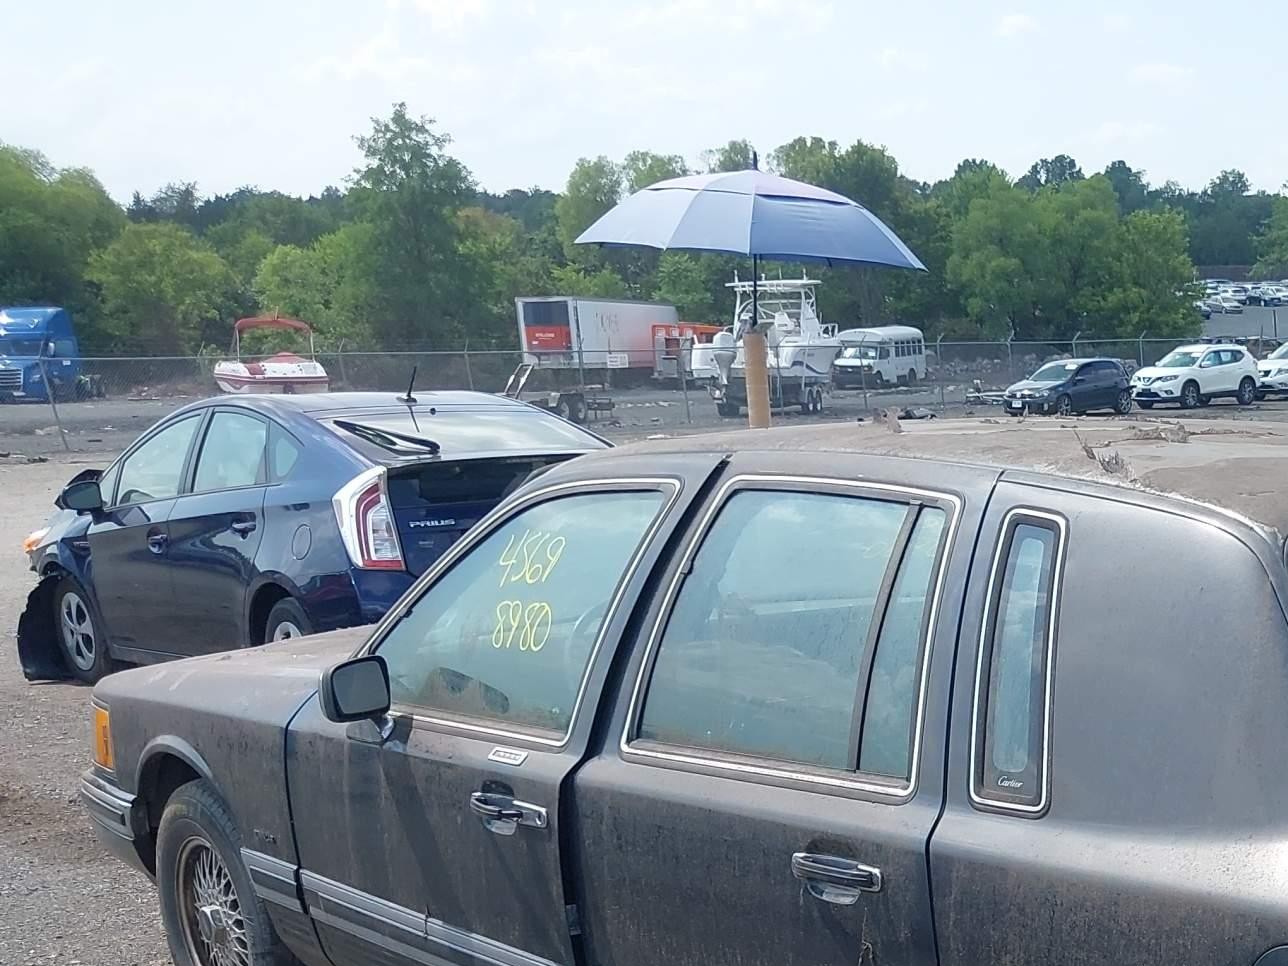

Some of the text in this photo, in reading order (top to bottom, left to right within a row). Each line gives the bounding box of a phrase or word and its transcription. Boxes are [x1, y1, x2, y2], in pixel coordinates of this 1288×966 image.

[408, 518, 456, 528] PRIUS
[499, 529, 566, 588] 4569
[492, 600, 552, 651] 8980
[997, 775, 1024, 788] Cartier
